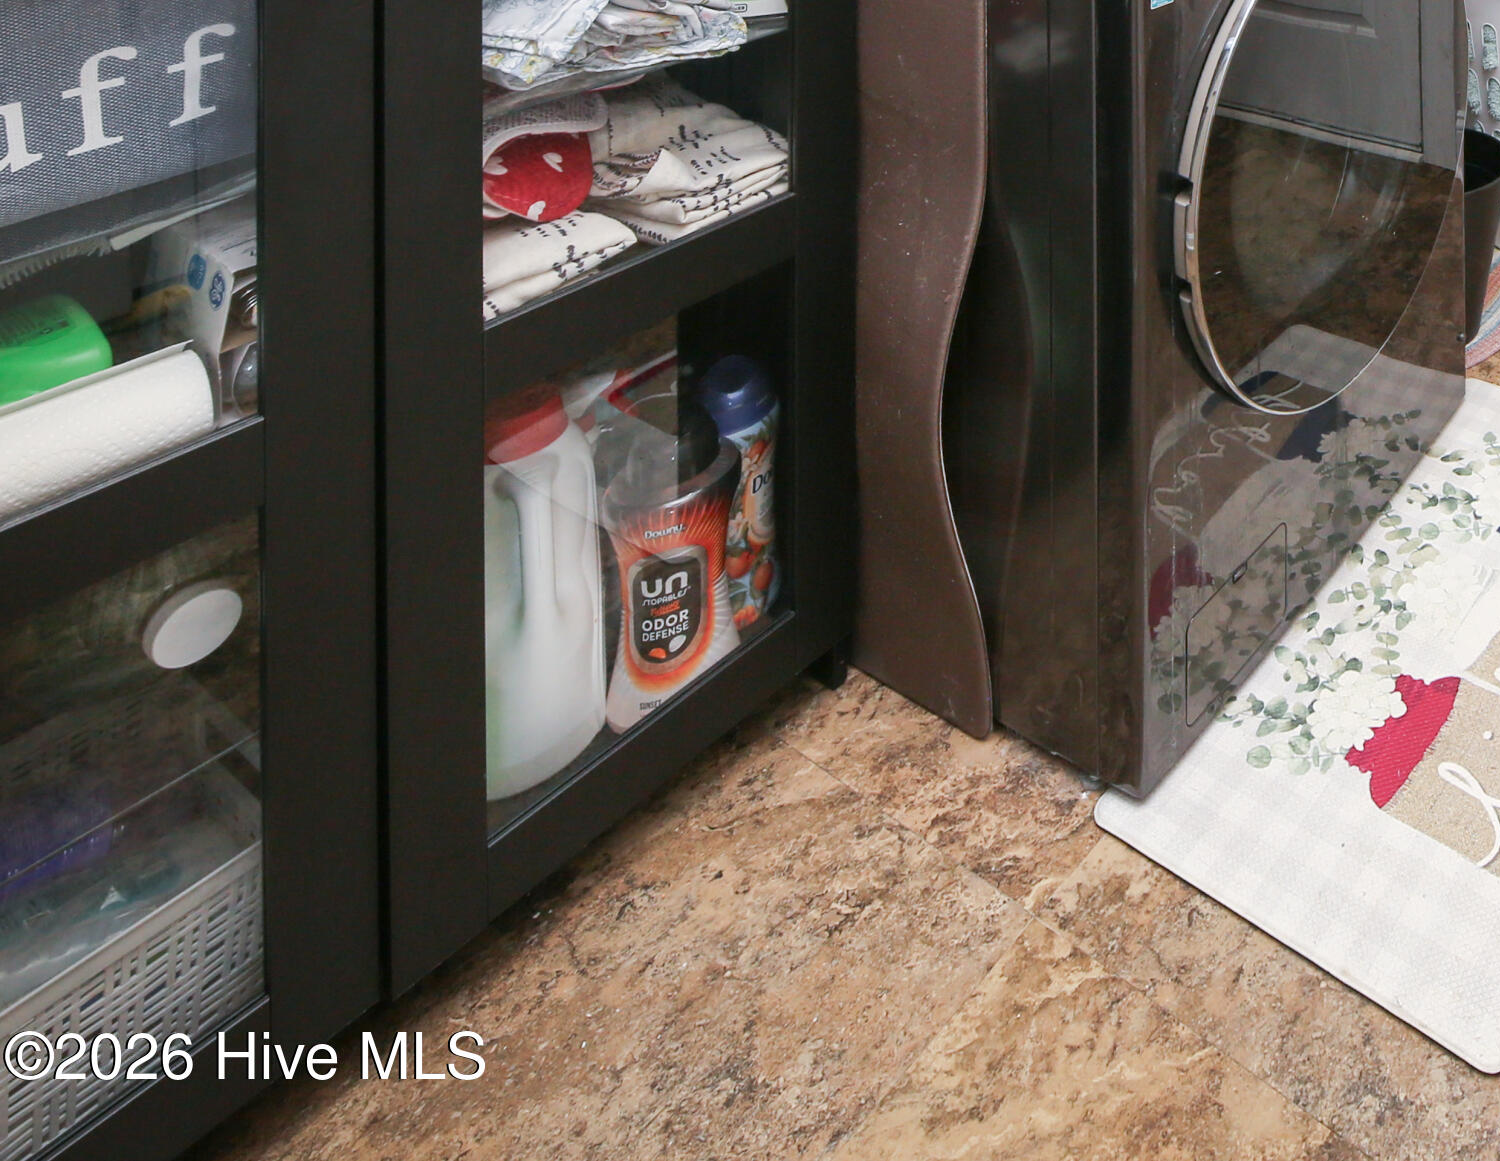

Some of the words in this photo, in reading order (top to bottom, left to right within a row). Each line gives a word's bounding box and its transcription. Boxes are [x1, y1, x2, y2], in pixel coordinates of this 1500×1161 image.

[644, 524, 685, 540] Downy
[642, 609, 689, 632] ODOR
[642, 623, 689, 642] DEFENSE
